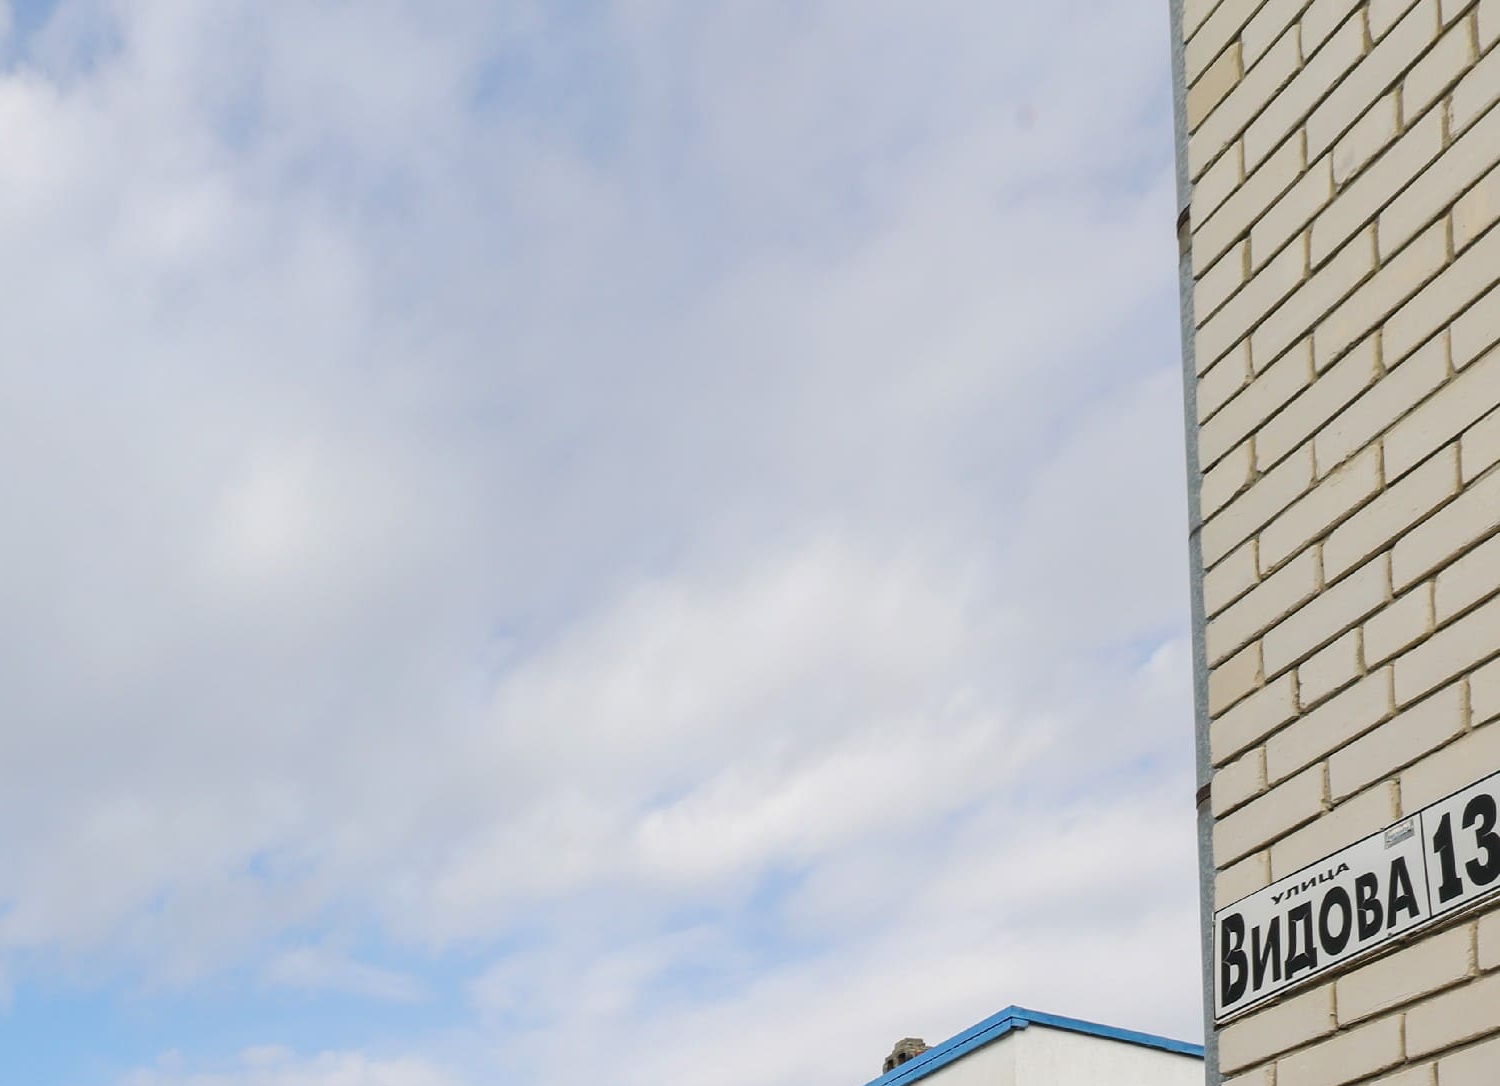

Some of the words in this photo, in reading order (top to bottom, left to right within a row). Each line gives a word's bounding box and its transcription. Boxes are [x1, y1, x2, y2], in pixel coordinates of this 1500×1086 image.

[1221, 856, 1420, 1008] ВИДОВА
[1433, 793, 1500, 904] 13
[1271, 863, 1350, 904] УЛИЦА
